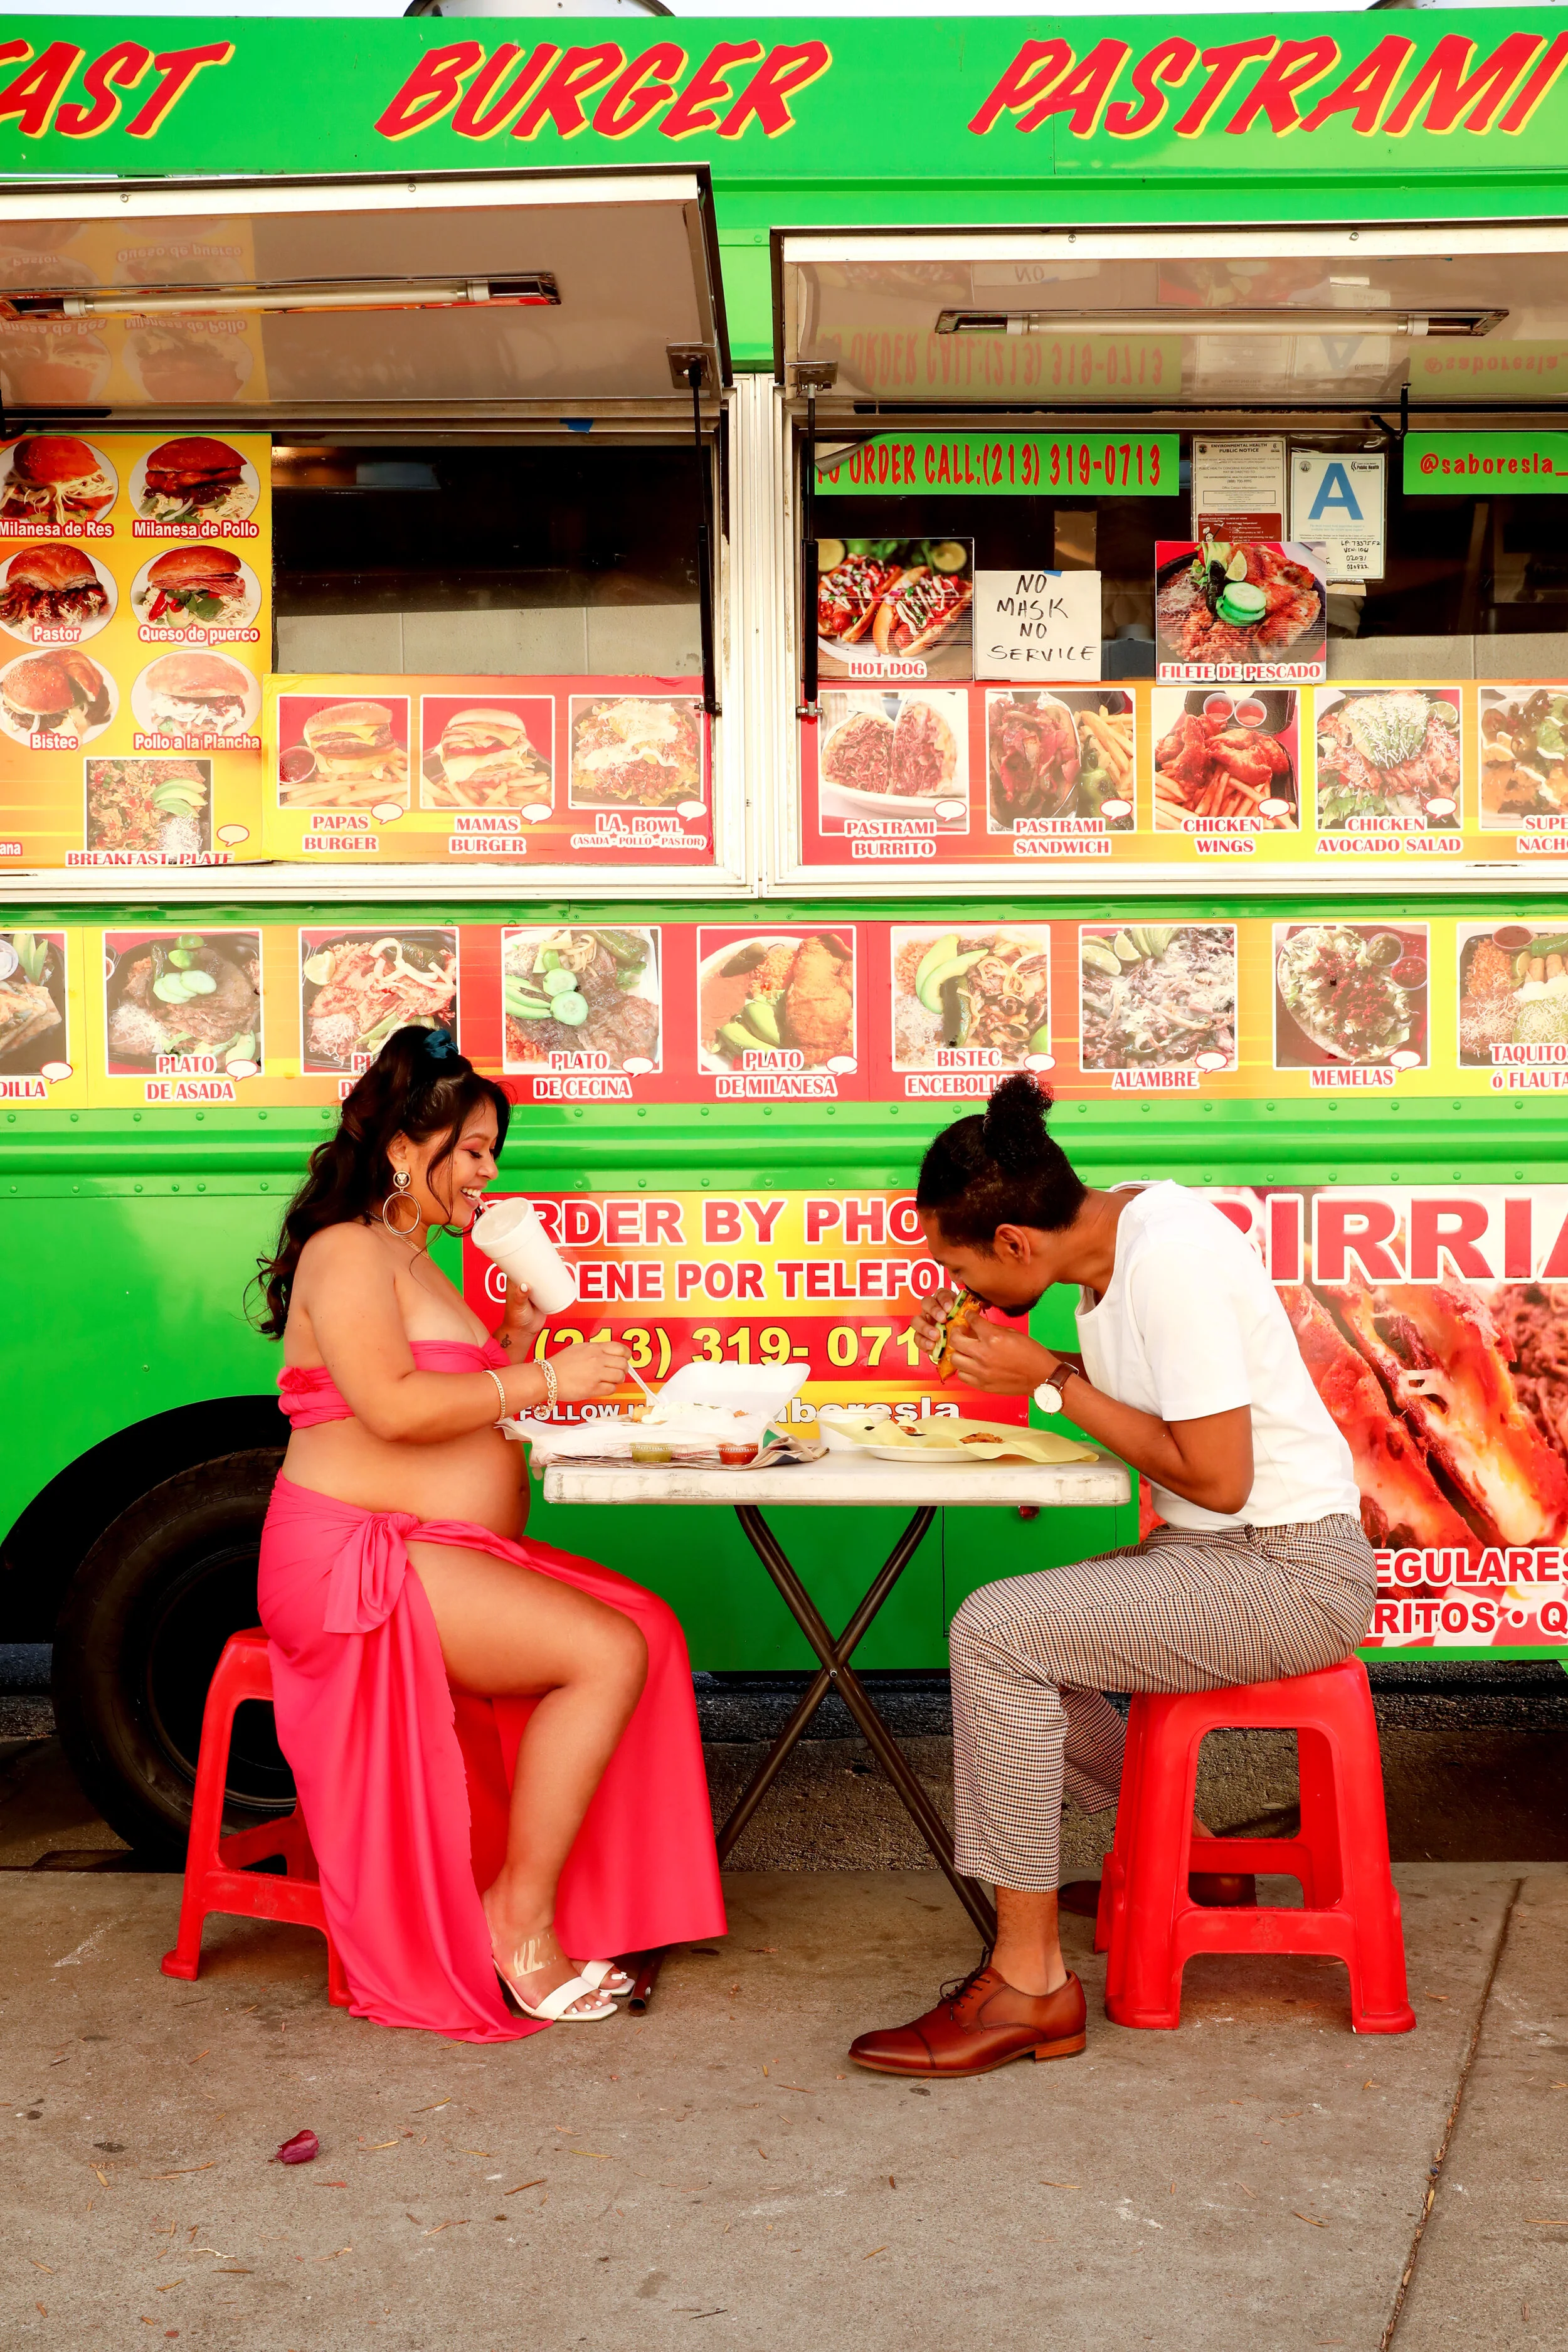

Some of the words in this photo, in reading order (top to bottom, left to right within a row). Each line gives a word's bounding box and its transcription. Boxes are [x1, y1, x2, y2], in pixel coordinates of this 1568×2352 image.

[374, 40, 832, 141] BURGER
[968, 31, 1568, 139] PASTRAMI
[849, 443, 916, 485] ORDER
[1049, 443, 1162, 487] 319-0713
[1308, 462, 1364, 521] A
[0, 521, 61, 537] Milanesa
[65, 521, 82, 536] de
[85, 521, 113, 537] Res
[134, 521, 197, 537] Milanesa
[199, 521, 218, 537] de
[221, 521, 258, 537] Pollo
[1015, 573, 1047, 594] NO
[33, 627, 80, 642] Pastor
[139, 627, 184, 642] Queso
[188, 627, 205, 642] de
[209, 629, 259, 645] puerco
[1020, 622, 1047, 639] NO
[987, 645, 1098, 661] SERVICE
[850, 662, 886, 675] HOT
[889, 662, 925, 675] DOG
[1162, 664, 1215, 679] FILETE
[1219, 664, 1244, 679] DE
[1248, 664, 1322, 679] PESCADO
[32, 734, 78, 749] Bistec
[134, 734, 170, 749] Pollo
[172, 738, 184, 749] a
[186, 734, 200, 749] la
[203, 734, 261, 749] Plancha
[312, 815, 369, 829] PAPAS
[457, 818, 519, 831] MAMAS
[634, 819, 681, 833] BOWL
[846, 821, 935, 834] PASTRAMI
[1015, 820, 1103, 833] PASTRAMI
[1182, 818, 1261, 832] CHICKEN
[1347, 817, 1426, 831] CHICKEN
[304, 837, 376, 850] BURGER
[451, 838, 524, 852] BURGER
[618, 835, 652, 846] POLLO
[854, 841, 934, 855] BURRITO
[1015, 840, 1109, 854] SANDWICH
[1196, 839, 1254, 853] WINGS
[1316, 838, 1401, 852] AVOCADO
[1406, 838, 1461, 852] SALAD
[1519, 837, 1568, 852] NACH
[67, 853, 170, 866] BREAKFAST
[745, 1051, 802, 1068] PLATO
[937, 1051, 1001, 1067] BISTEC
[1491, 1045, 1568, 1062] TAQUITO
[158, 1056, 215, 1073] PLATO
[551, 1054, 609, 1071] PLATO
[718, 1078, 743, 1095] DE
[745, 1077, 835, 1094] MILANESA
[907, 1077, 1005, 1094] ENCEBOLL
[1113, 1071, 1197, 1088] ALAMBRE
[1311, 1070, 1394, 1086] MEMELAS
[147, 1083, 171, 1100] DE
[176, 1083, 234, 1099] ASADA
[536, 1081, 562, 1097] DE
[564, 1079, 630, 1096] CECINA
[480, 1200, 684, 1245] RDER
[705, 1200, 786, 1243] BY
[807, 1199, 927, 1243] PHO
[487, 1263, 663, 1301] OENE
[677, 1263, 765, 1299] POR
[777, 1261, 966, 1298] TELEFO
[827, 1325, 940, 1367] 071
[1375, 1551, 1568, 1583] EGULARE
[1365, 1601, 1496, 1634] RITOS
